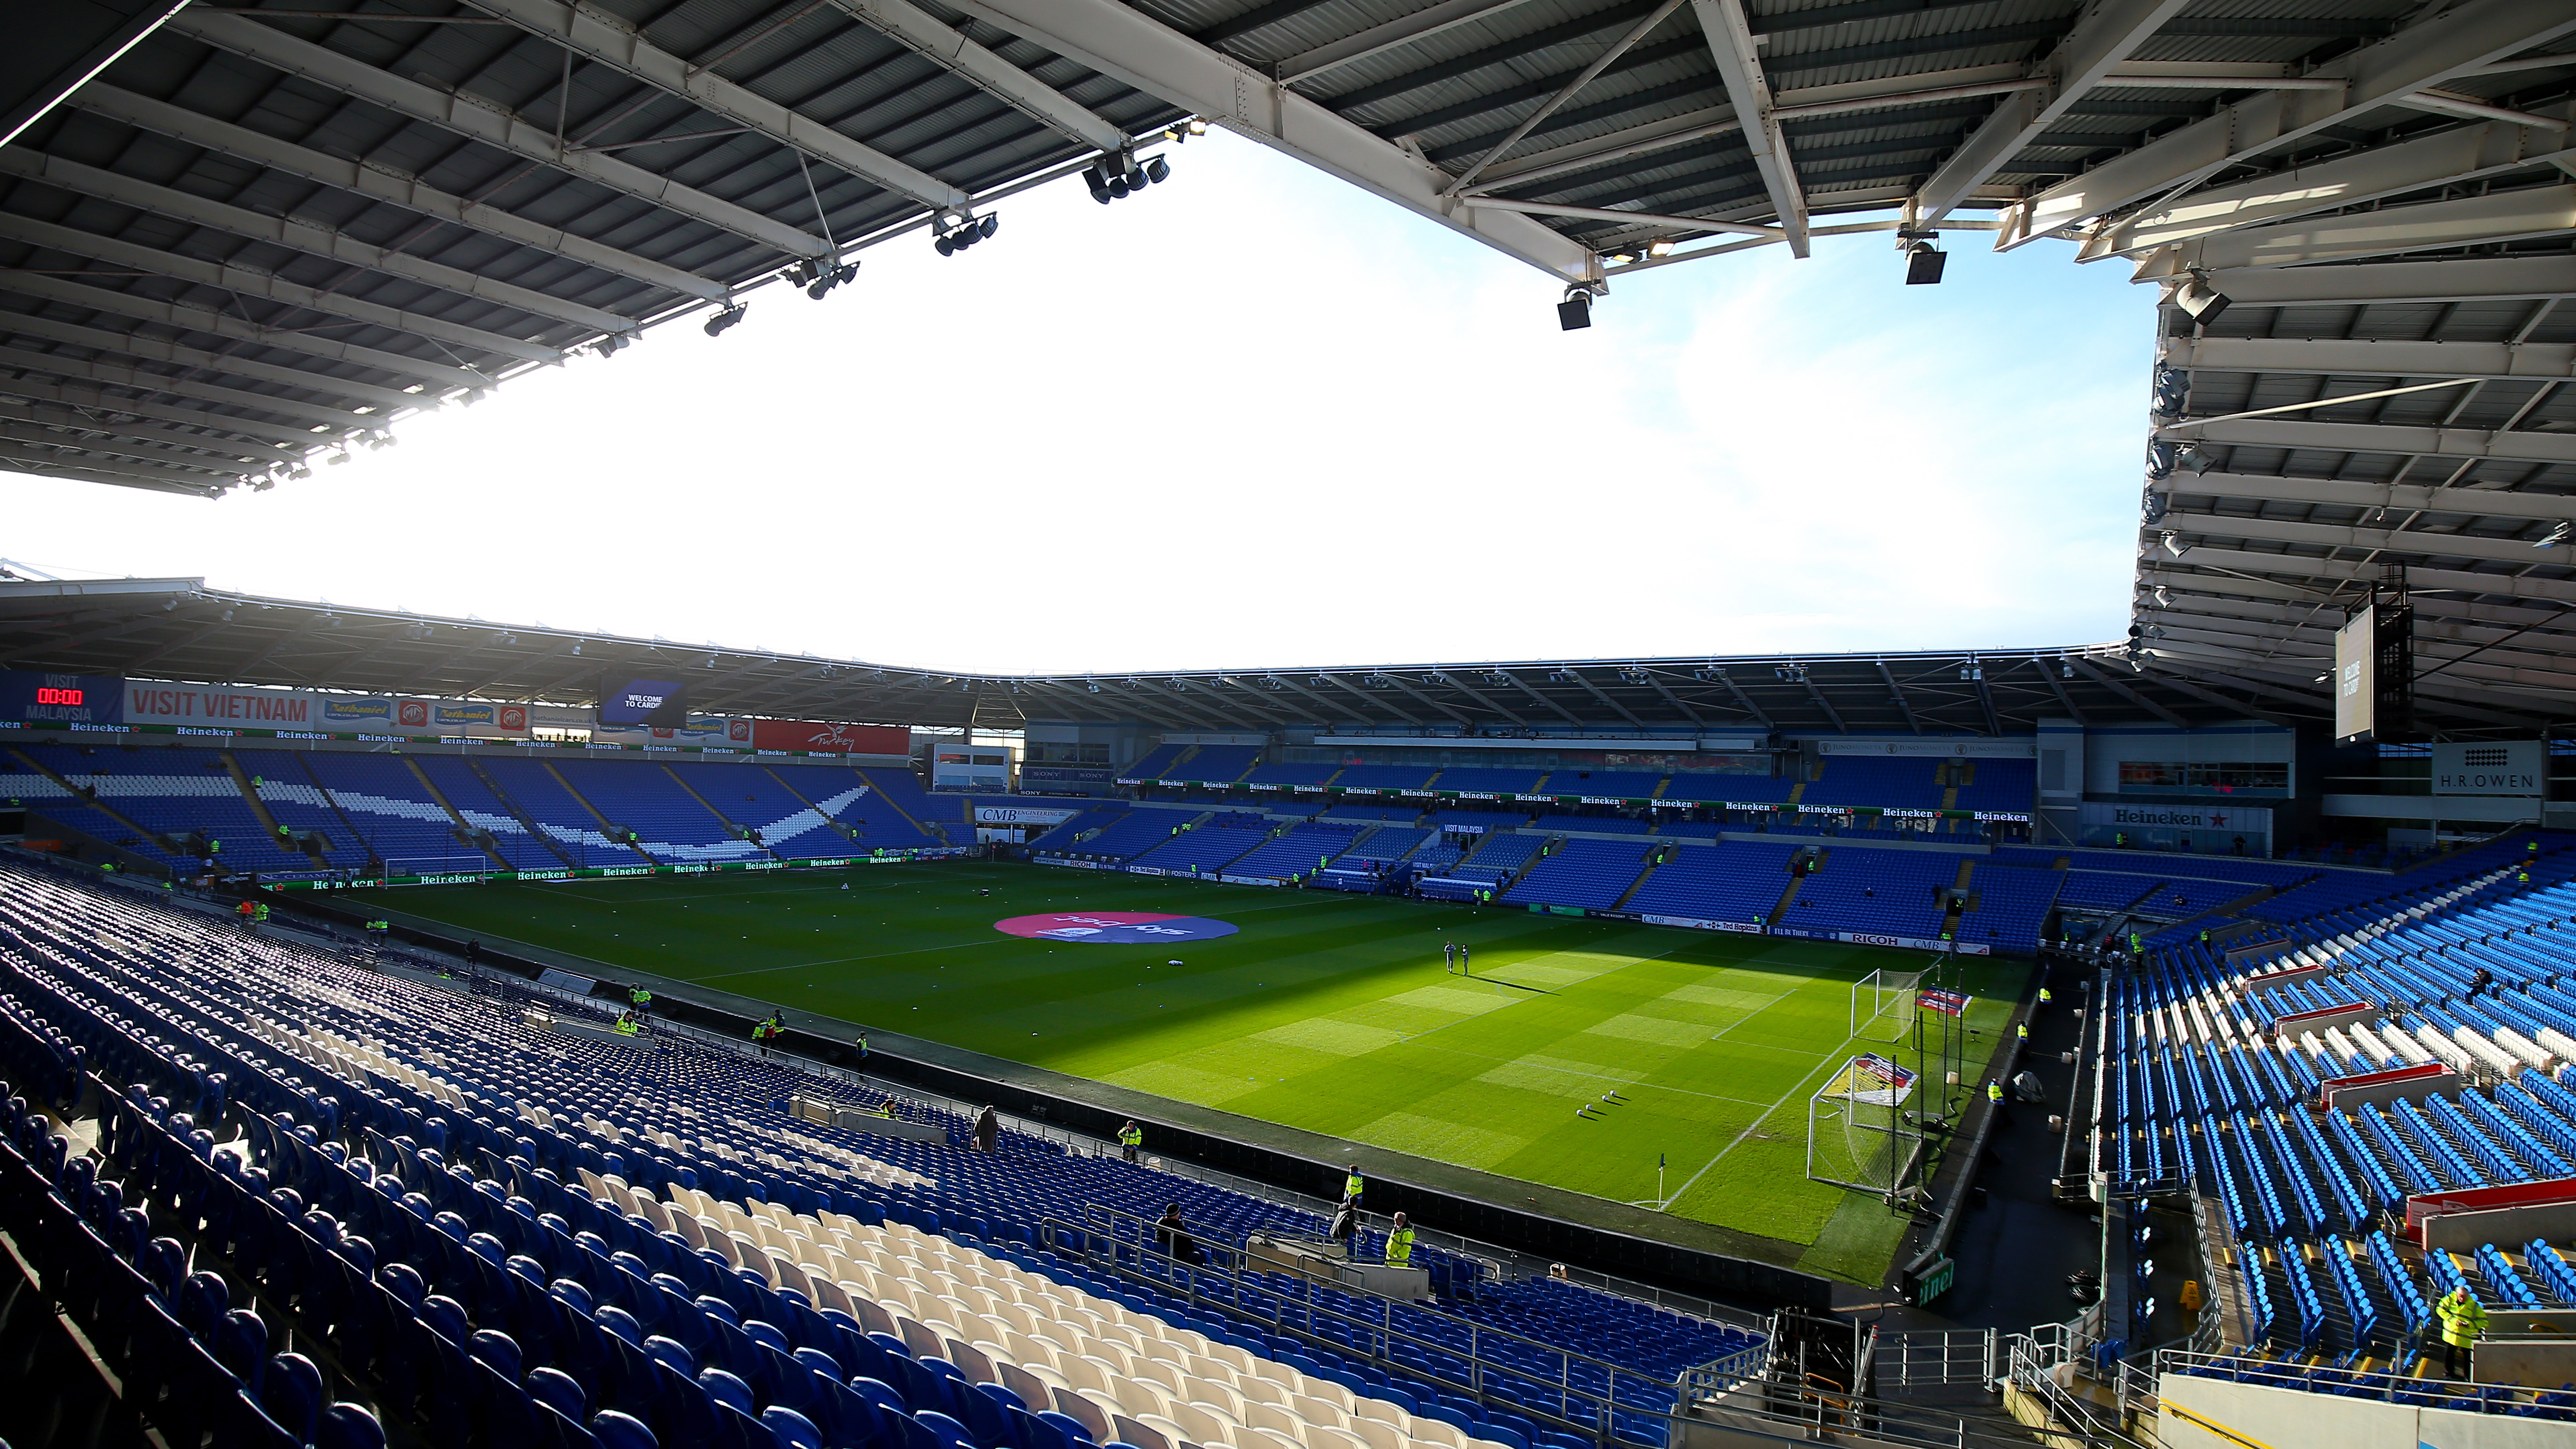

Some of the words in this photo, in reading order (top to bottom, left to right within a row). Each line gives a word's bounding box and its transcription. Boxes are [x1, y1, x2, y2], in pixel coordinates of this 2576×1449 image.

[45, 674, 79, 689] VISIT
[38, 687, 83, 705] 00:00
[628, 694, 663, 703] WELCOME
[133, 689, 197, 716] VISIT
[204, 694, 307, 722] VIETNAM
[26, 705, 92, 721] MALAYSIA
[533, 715, 592, 724] nathanielcars.co.uk
[70, 723, 130, 732] Heineken
[177, 727, 233, 736] Heineken
[276, 731, 327, 740] Heineken
[358, 734, 405, 743] Heineken
[440, 738, 484, 746] Heineken
[807, 732, 855, 752] Turkey
[1401, 789, 1433, 797] Heineken
[1459, 792, 1493, 800] Heineken
[1515, 794, 1552, 802] Heineken
[1581, 796, 1620, 805] Heineken
[1651, 799, 1692, 808] Heineken
[1726, 802, 1771, 812] Heineken
[1798, 804, 1845, 815] Heineken
[1883, 808, 1933, 818] Heineken
[983, 809, 1017, 821] CMB
[1974, 812, 2028, 822] Heineken
[2115, 808, 2203, 826] Heineken
[1458, 825, 1484, 834] MALAYSIA
[745, 862, 783, 870] Heineken
[810, 858, 845, 867] Heineken
[518, 871, 567, 881] Heineken
[603, 867, 648, 876] Heineken
[421, 874, 475, 885] Heineken
[1643, 915, 1664, 924] CMB
[1734, 923, 1757, 932] Hopkins
[1852, 934, 1899, 946] RICOH
[1913, 940, 1940, 949] CMB
